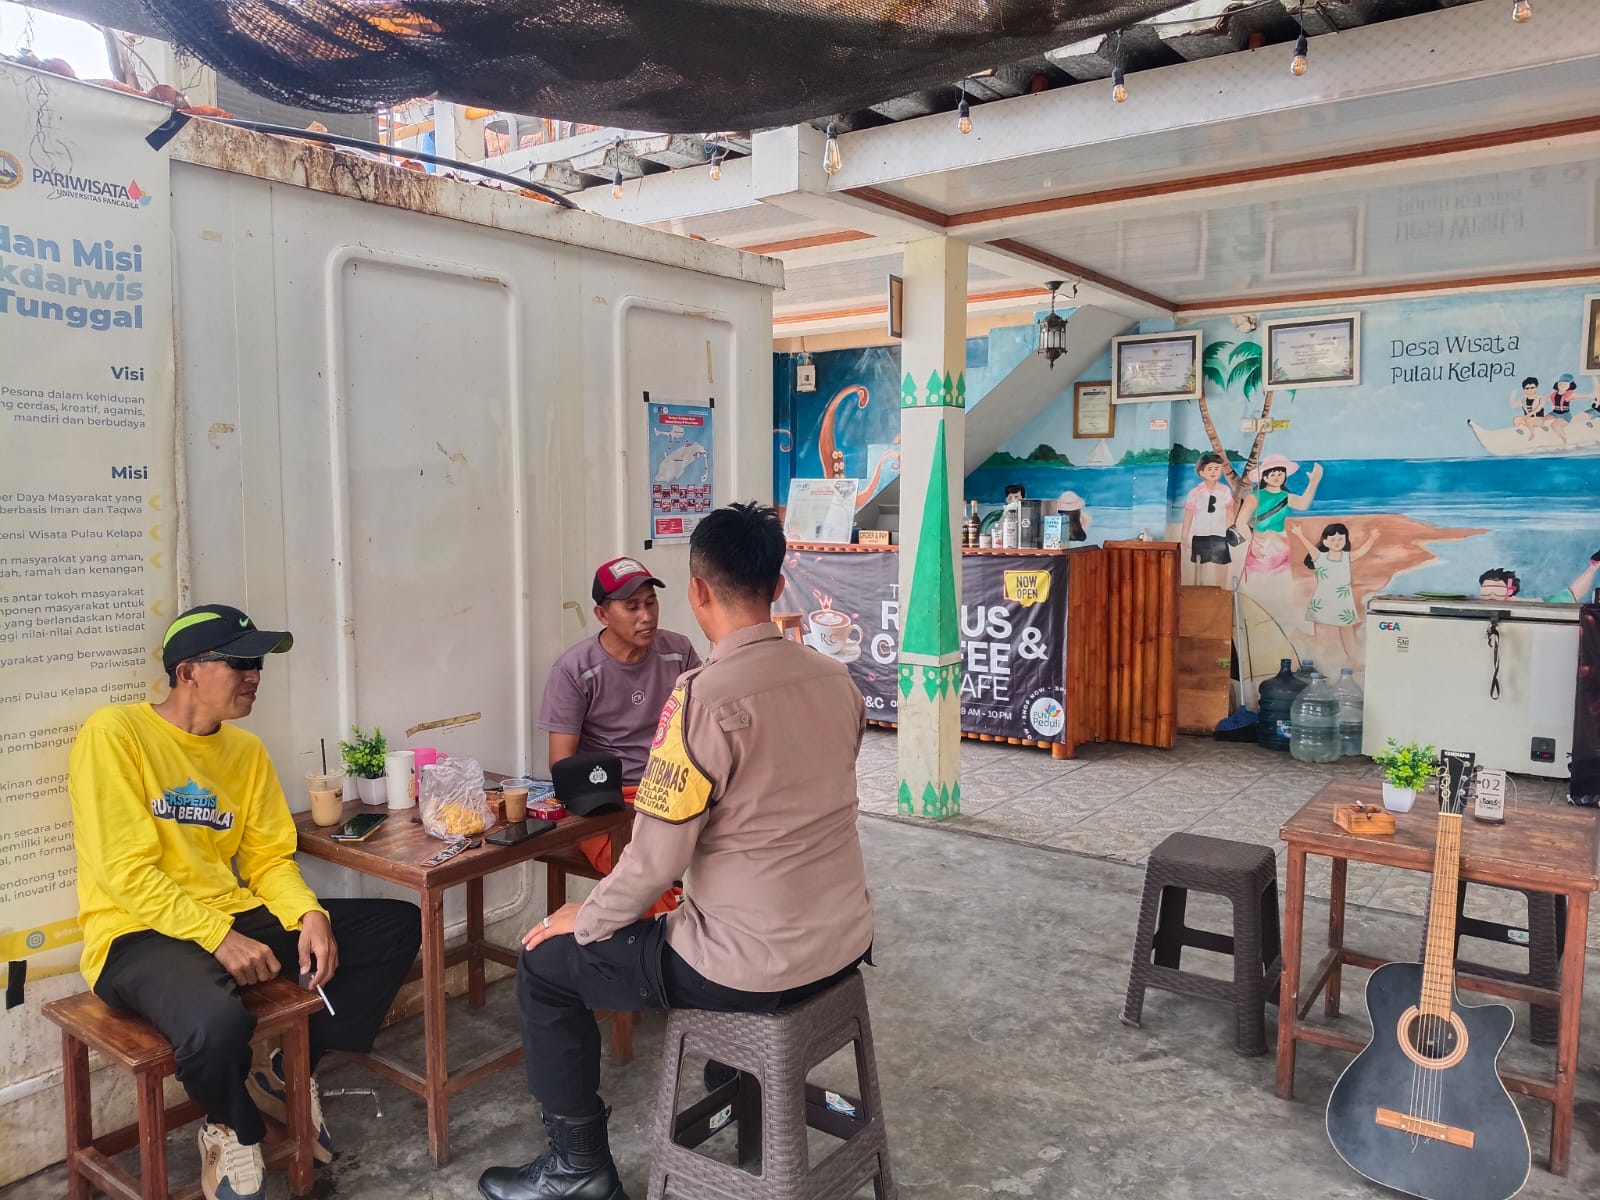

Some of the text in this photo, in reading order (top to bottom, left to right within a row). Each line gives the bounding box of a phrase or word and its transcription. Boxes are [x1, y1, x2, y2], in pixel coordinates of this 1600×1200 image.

[32, 168, 130, 200] PARIWISATA
[56, 188, 139, 209] UNIVERSITAS PANCASILA
[72, 238, 143, 272] Misi
[0, 287, 143, 331] Tunggal
[1390, 334, 1520, 358] Desa Wisata
[111, 366, 144, 381] Visi
[1390, 360, 1516, 384] Pulau Kelapa
[1, 386, 145, 405] Pesona dalam kehidupan
[17, 399, 58, 413] cerdas,
[61, 403, 101, 415] kreatif,
[103, 408, 146, 417] agamis,
[14, 413, 146, 430] mandiri dan berbudaya
[111, 465, 148, 480] Misi
[16, 493, 45, 503] Daya
[48, 493, 113, 503] Masyarakat
[115, 494, 142, 504] yang
[0, 505, 142, 517] berbasis Iman dan Taqwa
[28, 529, 68, 539] Wisata
[71, 529, 104, 539] Pulau
[106, 527, 143, 540] Kelapa
[10, 554, 77, 566] masyarakat
[79, 554, 107, 565] yang
[110, 553, 144, 563] aman,
[24, 566, 61, 577] ramah
[64, 566, 86, 576] dan
[89, 565, 144, 576] kenangan
[1016, 576, 1038, 589] NOW
[12, 593, 43, 603] antar
[45, 591, 78, 601] tokoh
[81, 588, 145, 600] masyarakat
[1017, 588, 1038, 600] OPEN
[45, 601, 110, 615] masyarakat
[113, 599, 145, 609] untuk
[4, 611, 145, 629] yang berlandaskan Moral
[1379, 621, 1401, 631] GEA
[21, 626, 73, 640] nilai-nilai
[75, 625, 103, 635] Adat
[105, 622, 145, 633] Istiadat
[1018, 626, 1049, 661] &
[46, 652, 74, 663] yang
[77, 646, 146, 659] berwawasan
[90, 658, 146, 670] Pariwisata
[25, 689, 57, 700] Pulau
[60, 685, 98, 697] Kelapa
[101, 680, 146, 693] disemua
[960, 674, 1010, 701] AFE
[109, 691, 146, 704] bidang
[967, 709, 981, 717] AM
[987, 709, 998, 718] 10
[999, 711, 1012, 721] PM
[1033, 710, 1048, 719] PLN
[29, 722, 78, 740] generasi
[1033, 717, 1061, 729] Peduli
[647, 798, 670, 814] UTARA
[14, 824, 51, 838] secara
[0, 835, 41, 855] emiliki
[14, 851, 36, 863] non
[14, 881, 57, 900] inovatif
